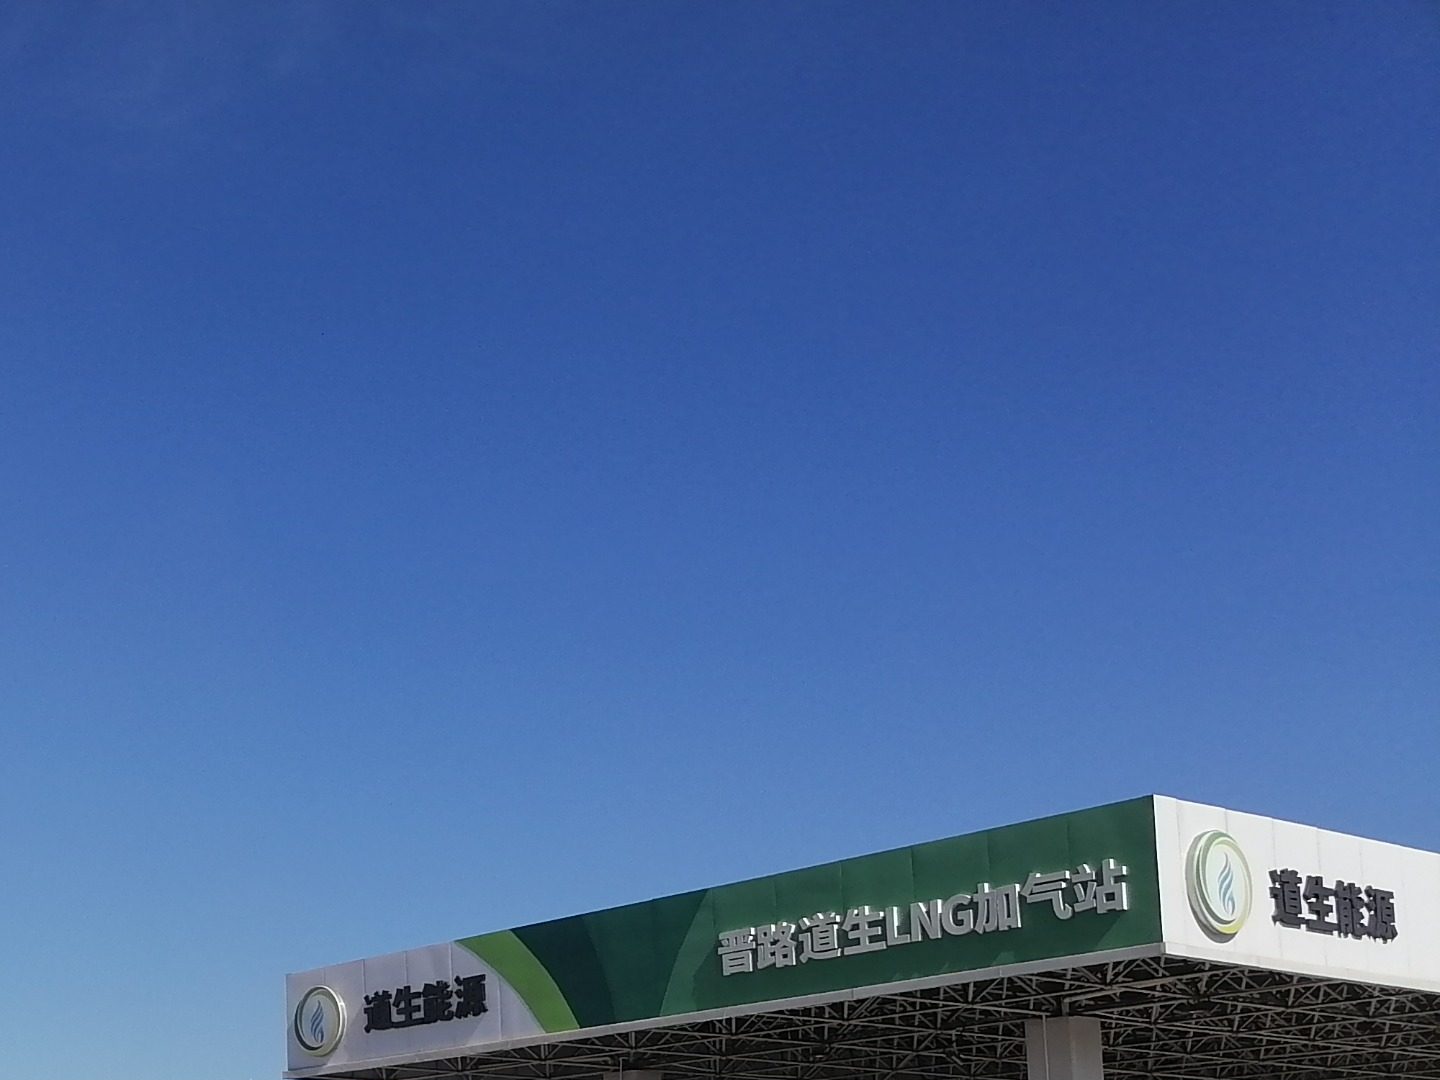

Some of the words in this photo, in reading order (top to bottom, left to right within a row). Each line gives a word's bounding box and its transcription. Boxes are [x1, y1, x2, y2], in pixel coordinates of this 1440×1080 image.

[717, 858, 1129, 977] 晋路道生LNG加气站
[1268, 867, 1399, 944] 道生能源
[363, 973, 489, 1034] 道生能源
